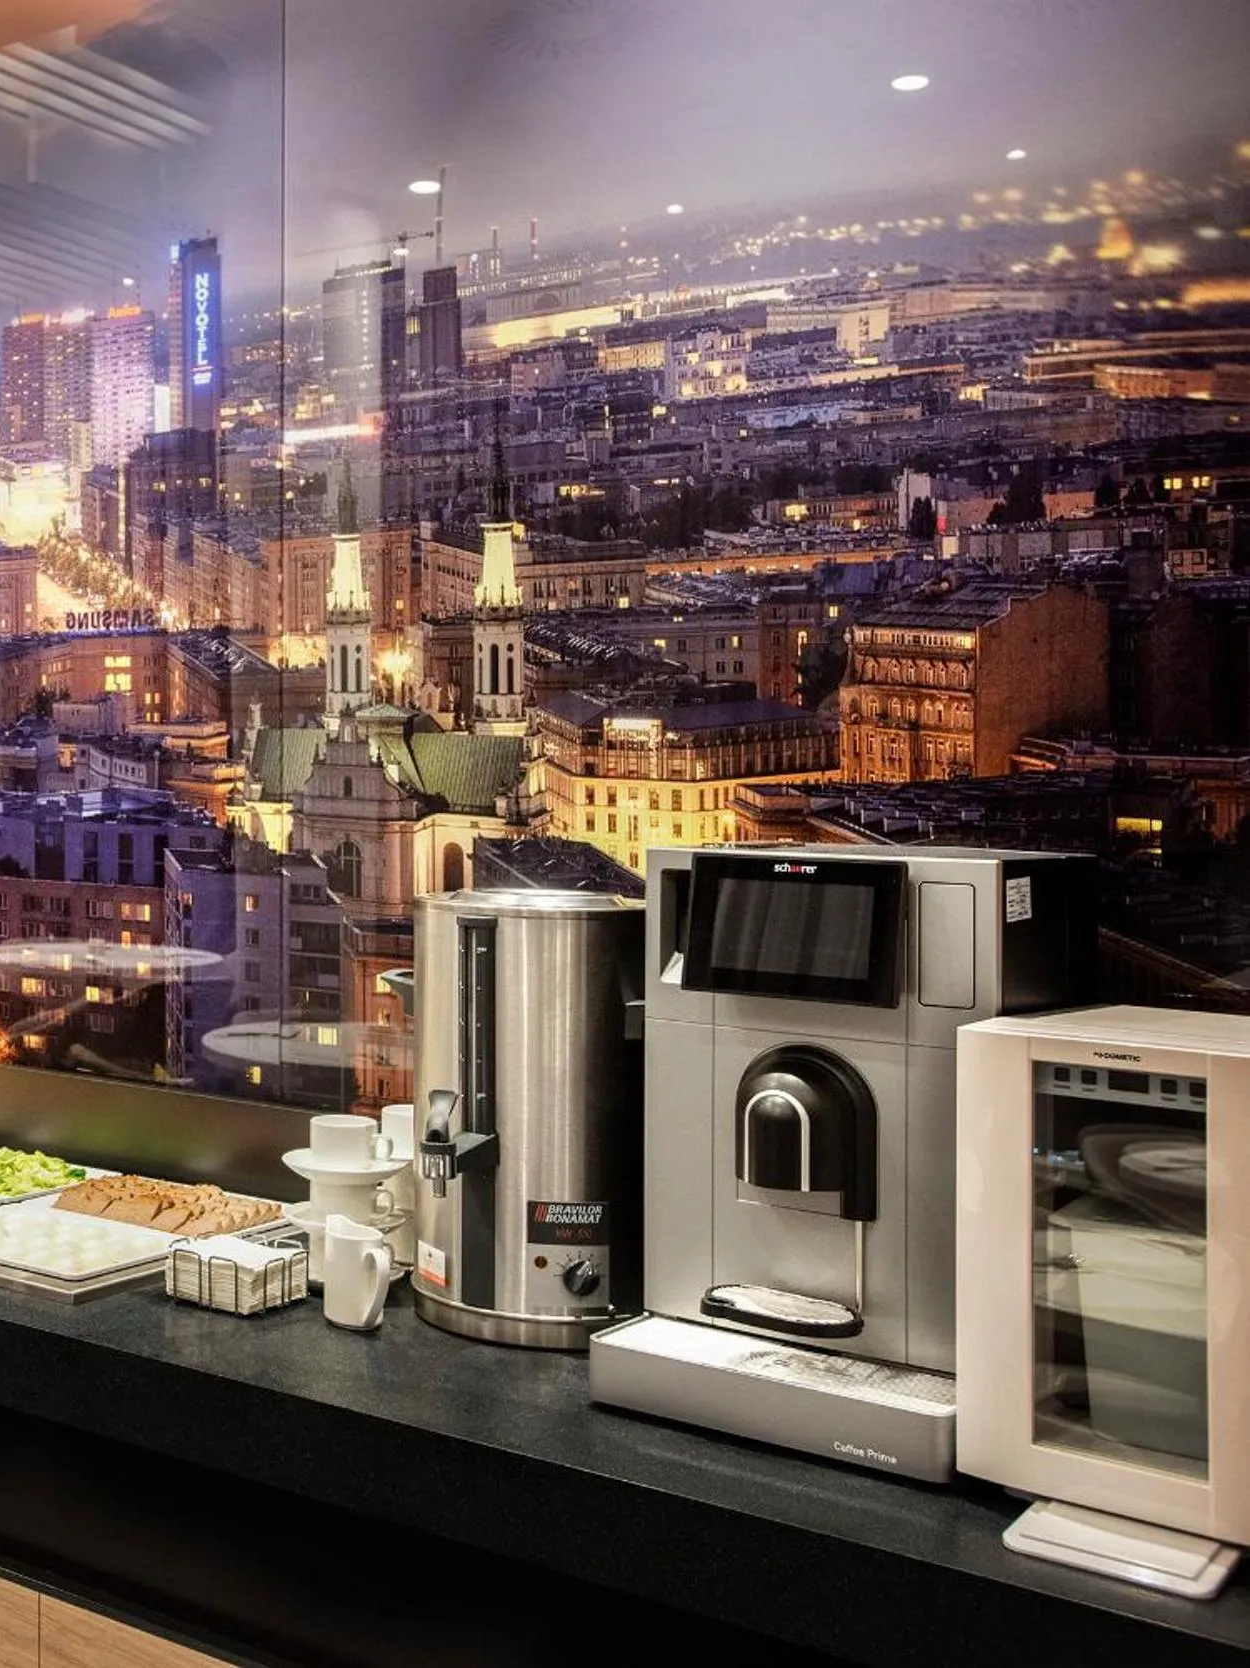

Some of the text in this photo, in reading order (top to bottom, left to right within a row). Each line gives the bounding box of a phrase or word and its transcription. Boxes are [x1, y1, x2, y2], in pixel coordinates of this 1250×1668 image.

[195, 272, 209, 365] NOVOTEL
[548, 1204, 603, 1215] BRAVILOR
[545, 1214, 602, 1224] BONAMAT
[833, 1441, 898, 1464] Coffee Prime
